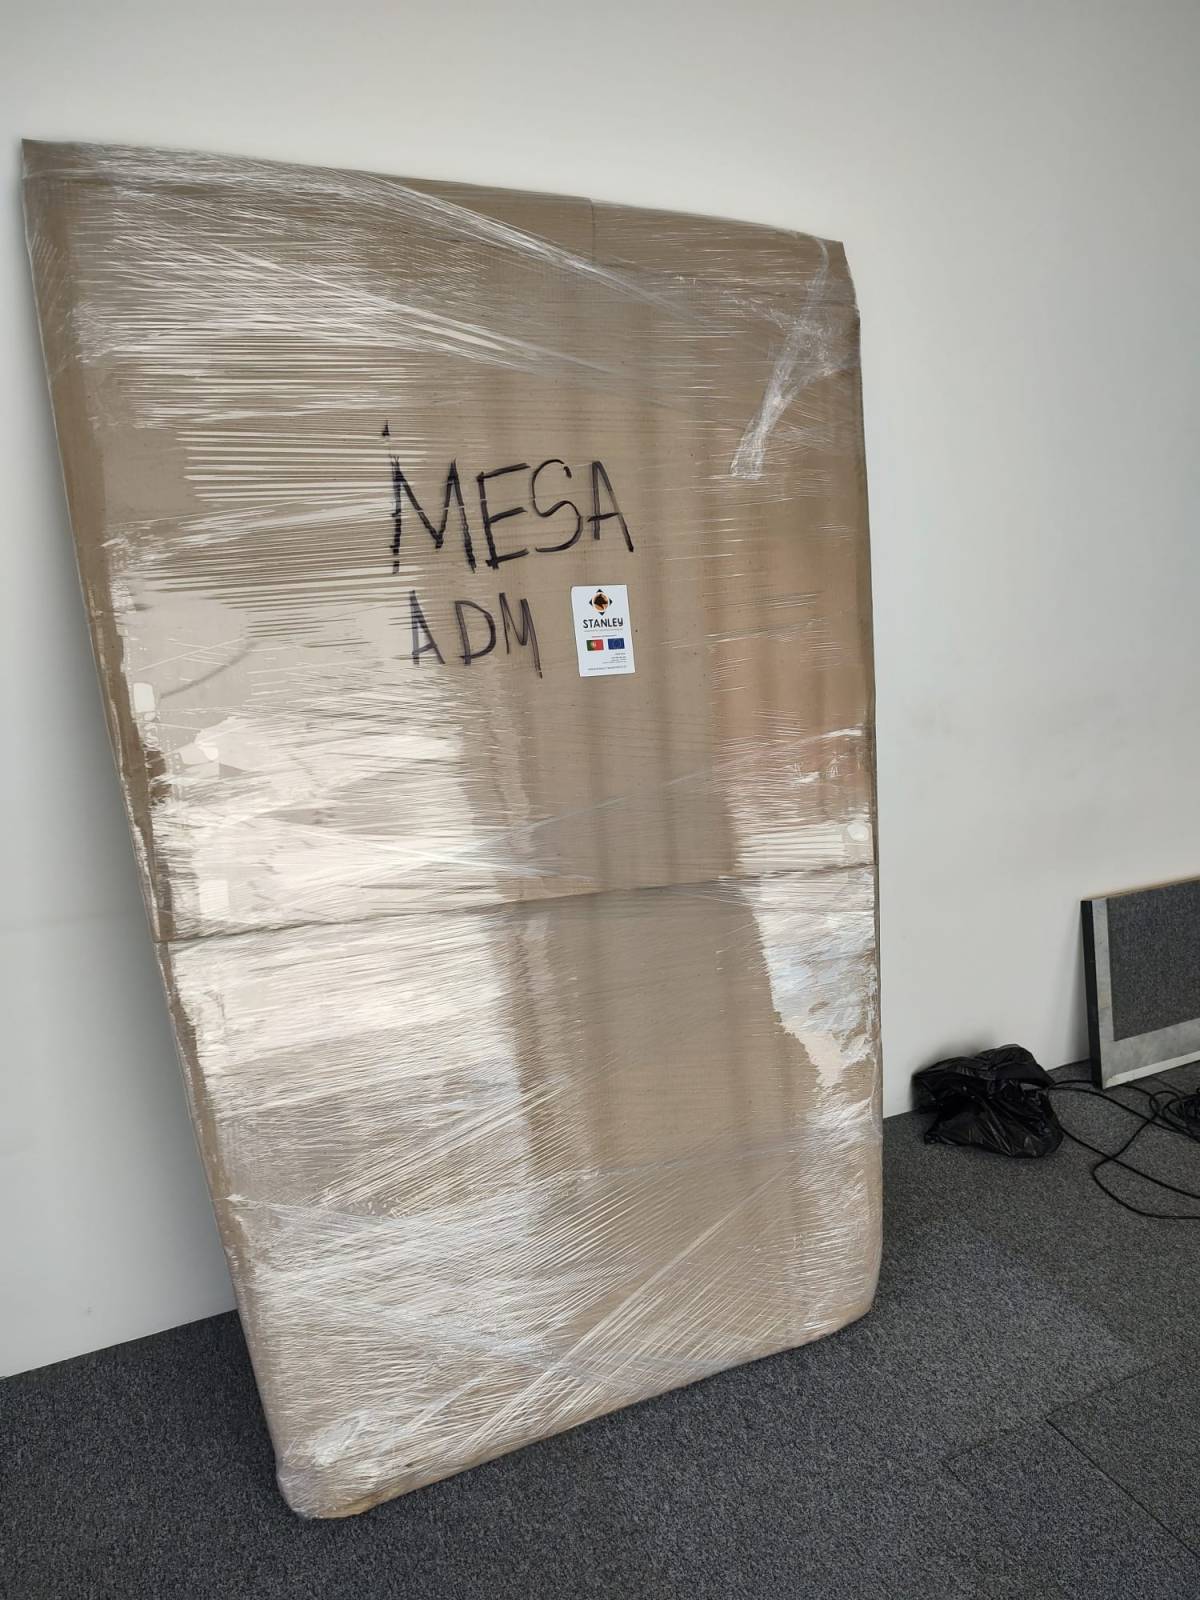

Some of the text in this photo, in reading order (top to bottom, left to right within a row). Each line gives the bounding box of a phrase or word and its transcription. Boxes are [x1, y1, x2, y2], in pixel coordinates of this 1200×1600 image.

[389, 456, 634, 574] MESA
[408, 590, 543, 678] ADM
[583, 617, 624, 629] STANLEY
